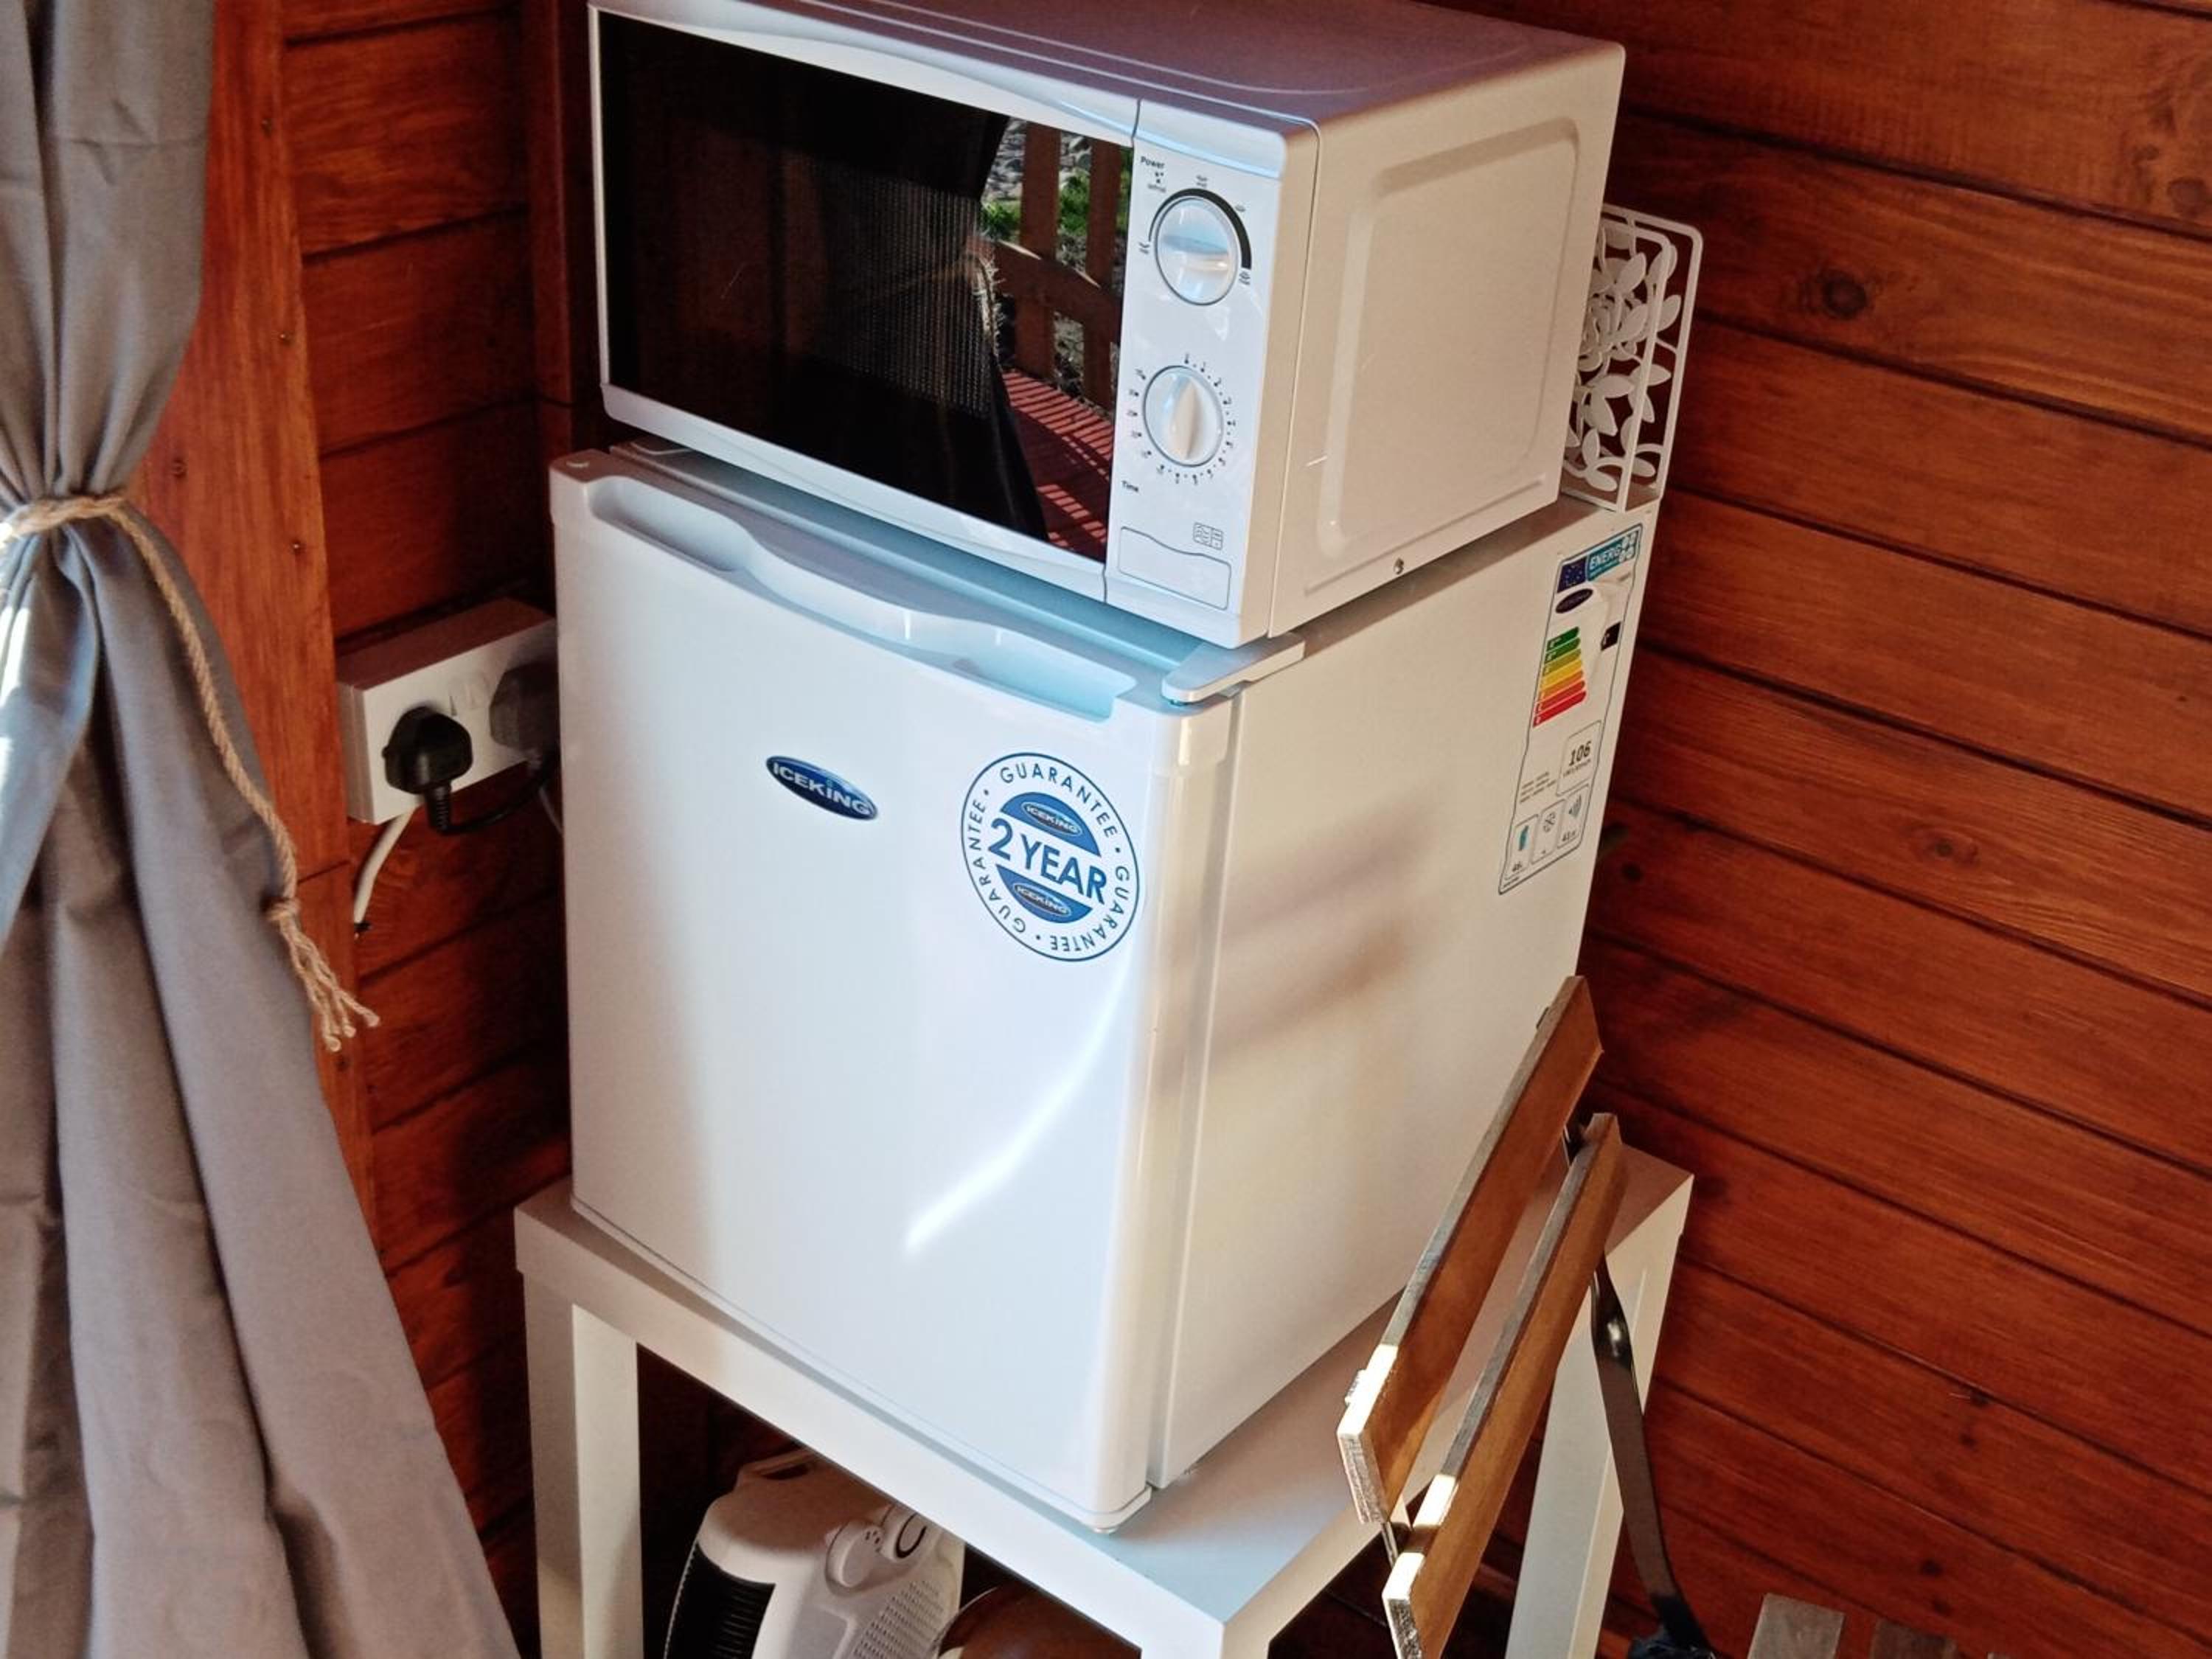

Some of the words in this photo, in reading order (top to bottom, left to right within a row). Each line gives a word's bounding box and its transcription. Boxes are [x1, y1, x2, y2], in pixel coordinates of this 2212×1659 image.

[1141, 156, 1165, 169] Power
[1121, 480, 1139, 492] Time
[1568, 740, 1592, 766] 106
[773, 762, 871, 815] ICEKING
[999, 762, 1118, 838] GUARANTEE
[968, 799, 1026, 933] GUARANTEE
[987, 818, 1014, 860] 2
[1020, 832, 1108, 905] YEAR
[1049, 865, 1130, 953] GUARANTEE
